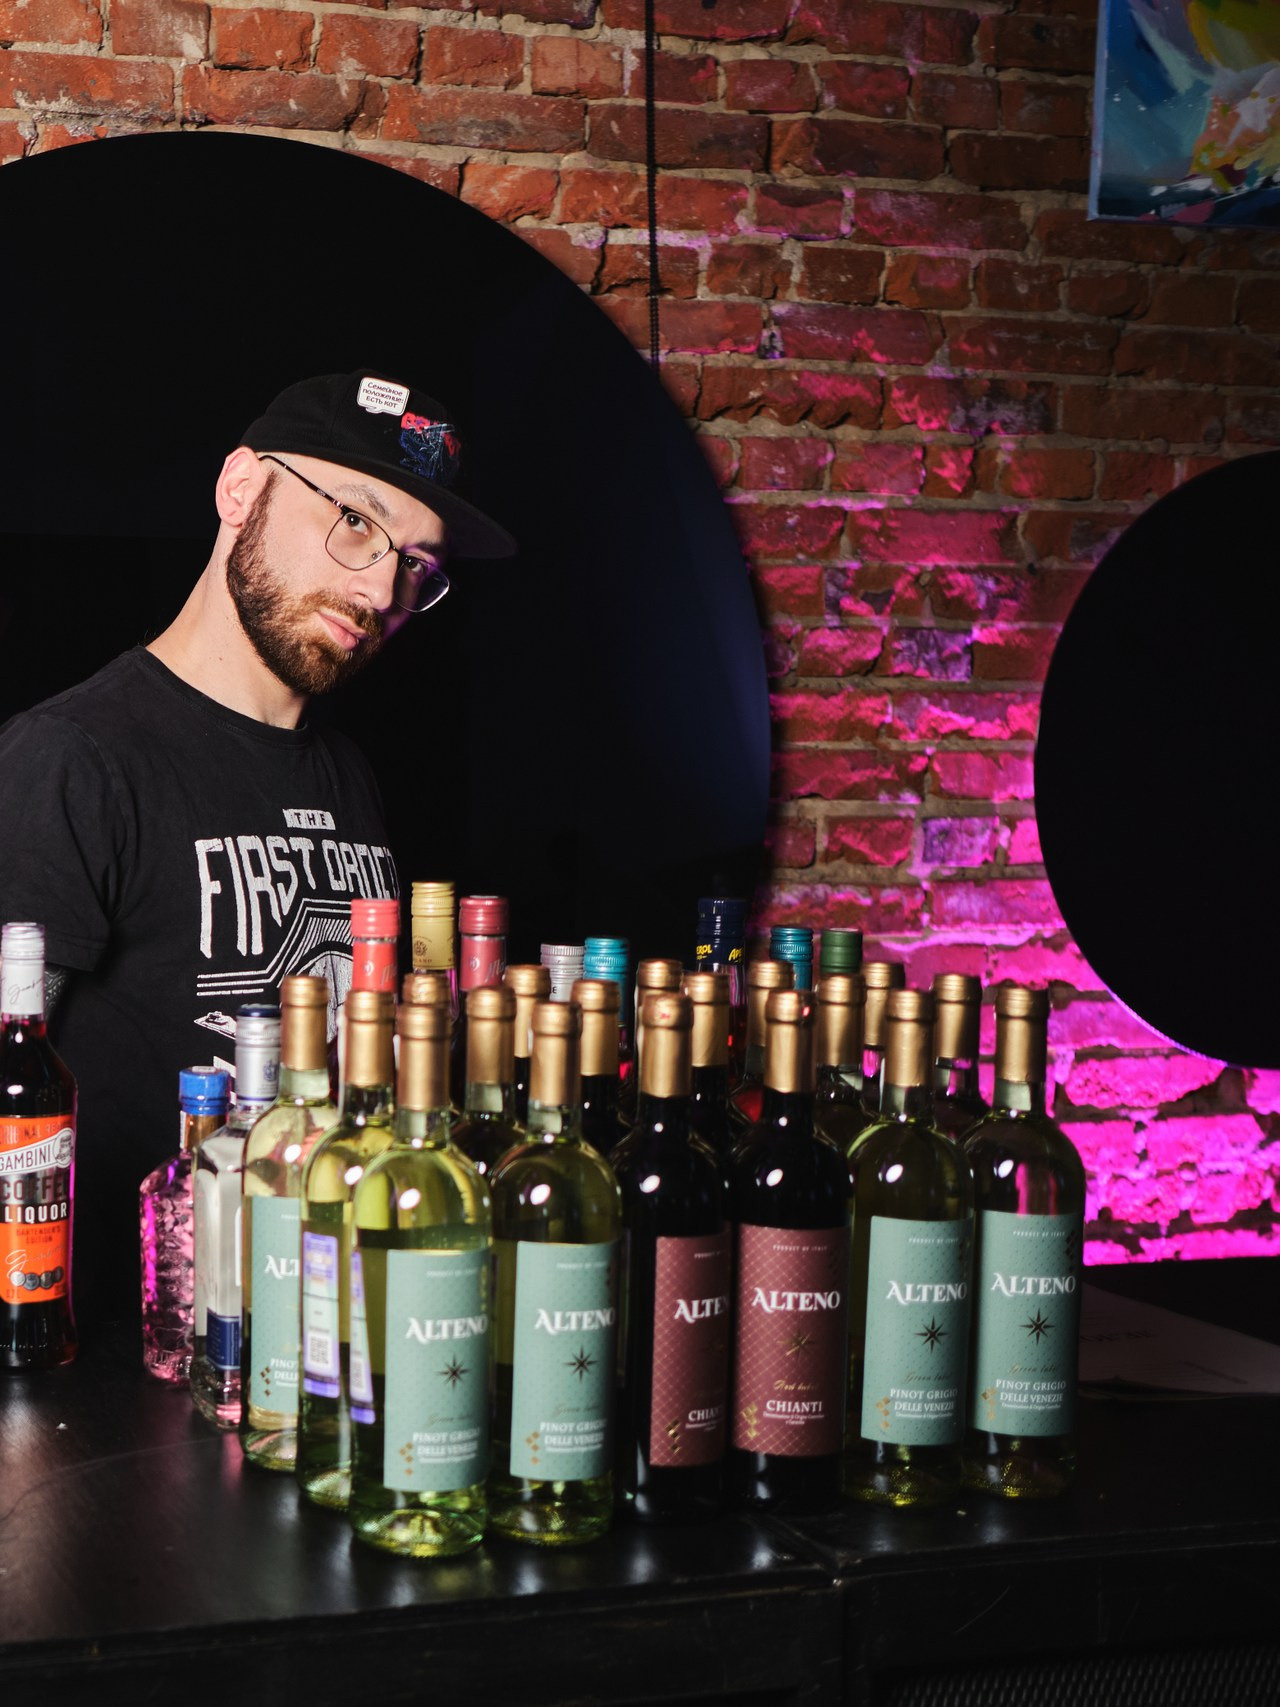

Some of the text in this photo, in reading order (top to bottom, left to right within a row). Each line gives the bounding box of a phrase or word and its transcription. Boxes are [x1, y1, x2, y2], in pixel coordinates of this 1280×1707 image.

[367, 382, 403, 396] Семейное
[366, 395, 399, 409] ЕСТЬ КОТ
[294, 812, 327, 826] THE
[194, 835, 317, 959] FIRST
[5, 1202, 68, 1224] LIQUOR
[991, 1271, 1076, 1297] ALTENO
[885, 1280, 967, 1306] ALTENO
[752, 1287, 841, 1314] ALTENO
[535, 1307, 616, 1335] ALTENO
[405, 1313, 489, 1345] ALTENO
[995, 1379, 1067, 1391] PINOT GRIGIO
[890, 1388, 958, 1400] PINOT GRIGIO
[1000, 1392, 1064, 1403] DELLE VENEZIE
[766, 1400, 823, 1413] CHIANTI
[894, 1401, 923, 1412] DELLE
[540, 1421, 575, 1433] PINOT
[412, 1431, 448, 1444] PINOT
[544, 1434, 573, 1446] DELLE
